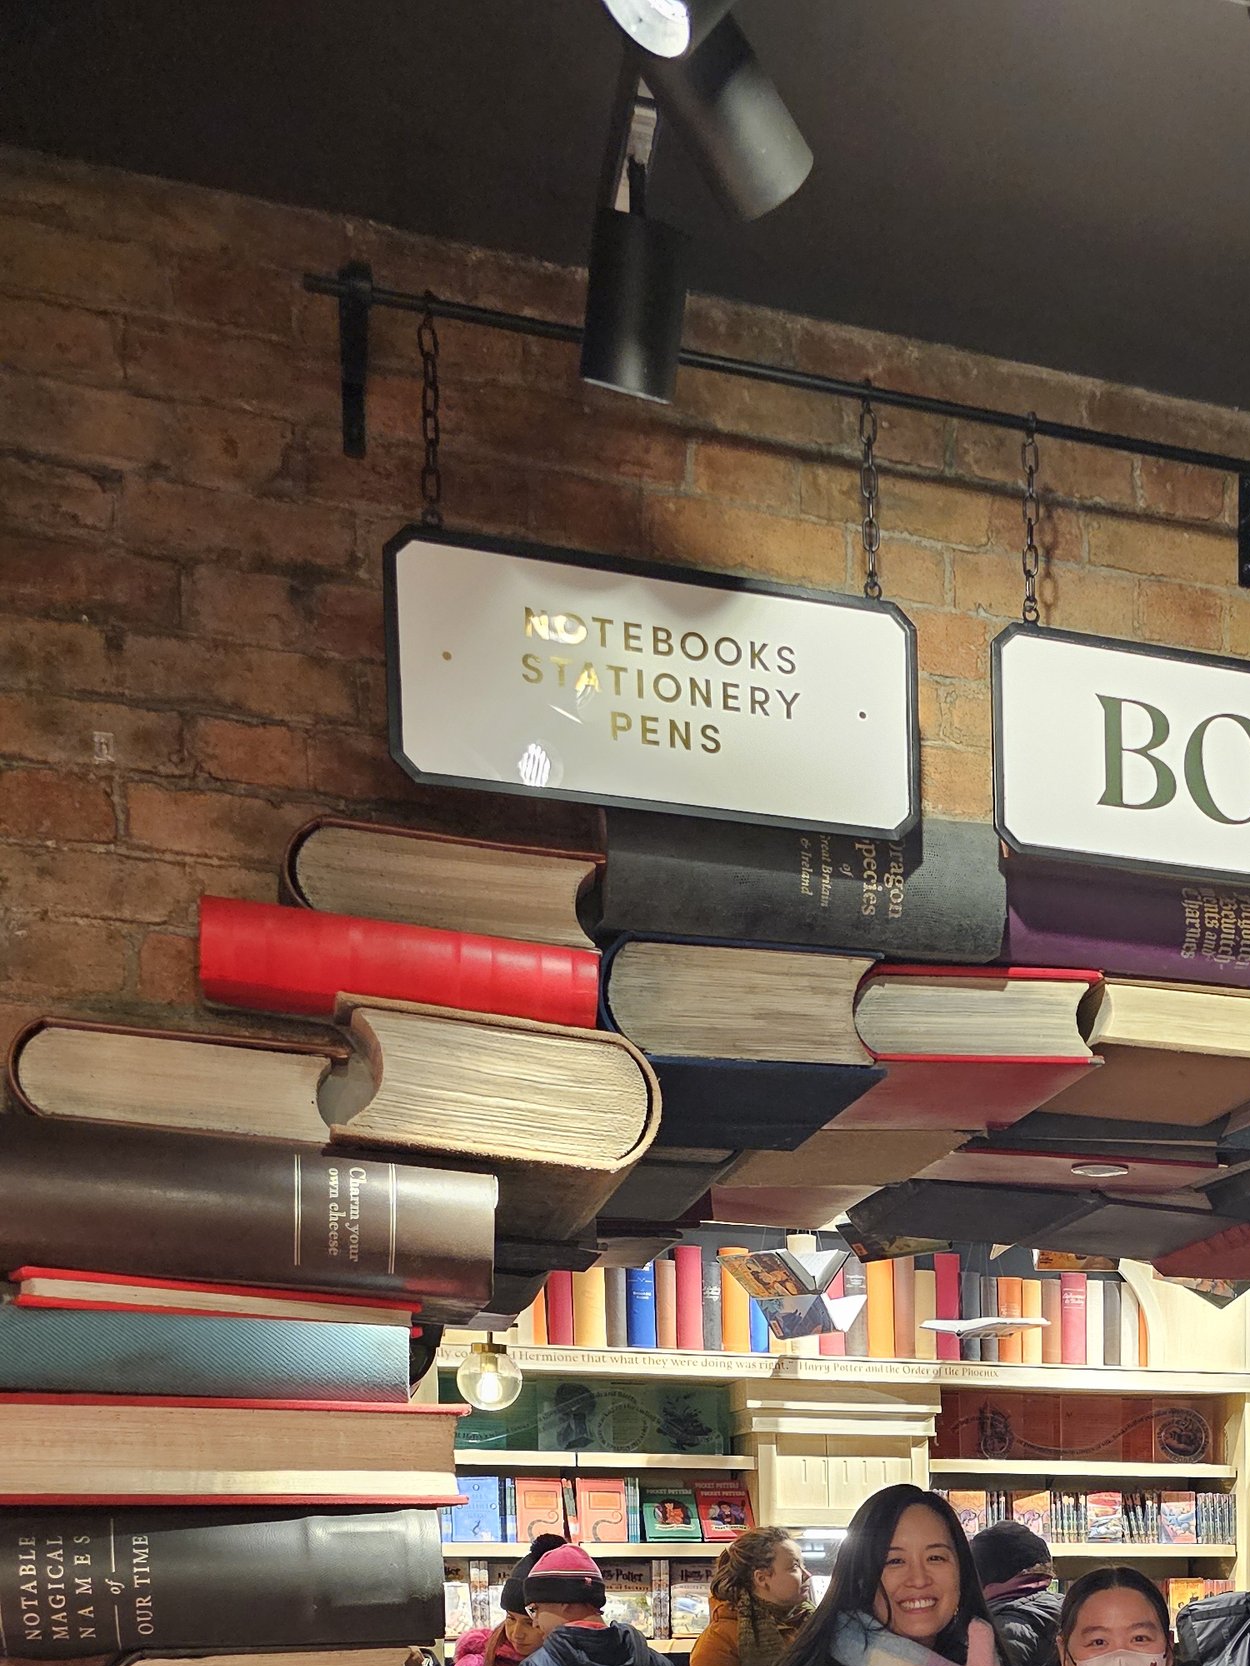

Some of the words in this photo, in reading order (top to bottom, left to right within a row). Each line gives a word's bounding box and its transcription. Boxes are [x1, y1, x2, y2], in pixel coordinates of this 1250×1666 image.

[523, 606, 798, 675] NOTEBOOKS
[520, 653, 802, 721] STATIONERY
[610, 711, 723, 754] PENS
[820, 835, 832, 862] reat
[800, 849, 814, 896] Ireland
[821, 864, 833, 907] Britain
[838, 863, 854, 878] of
[855, 838, 884, 916] pecies
[328, 1167, 340, 1199] own
[349, 1166, 368, 1220] Charm
[328, 1202, 346, 1257] cheese
[345, 1221, 360, 1263] your
[519, 1350, 579, 1363] Hermione
[581, 1351, 608, 1364] that
[609, 1354, 640, 1365] what
[642, 1356, 668, 1369] they
[670, 1358, 698, 1368] were
[701, 1358, 733, 1370] doing
[734, 1360, 757, 1370] was
[799, 1361, 830, 1374] Harry
[833, 1362, 862, 1374] Potter
[902, 1365, 930, 1376] Order
[932, 1367, 944, 1378] of
[961, 1368, 1000, 1378] Phoenix
[132, 1534, 151, 1590] TIME
[615, 1568, 643, 1583] Potter
[19, 1536, 42, 1641] NOTABLE
[46, 1535, 70, 1640] MAGICAL
[105, 1578, 126, 1596] of
[135, 1593, 156, 1636] OUR
